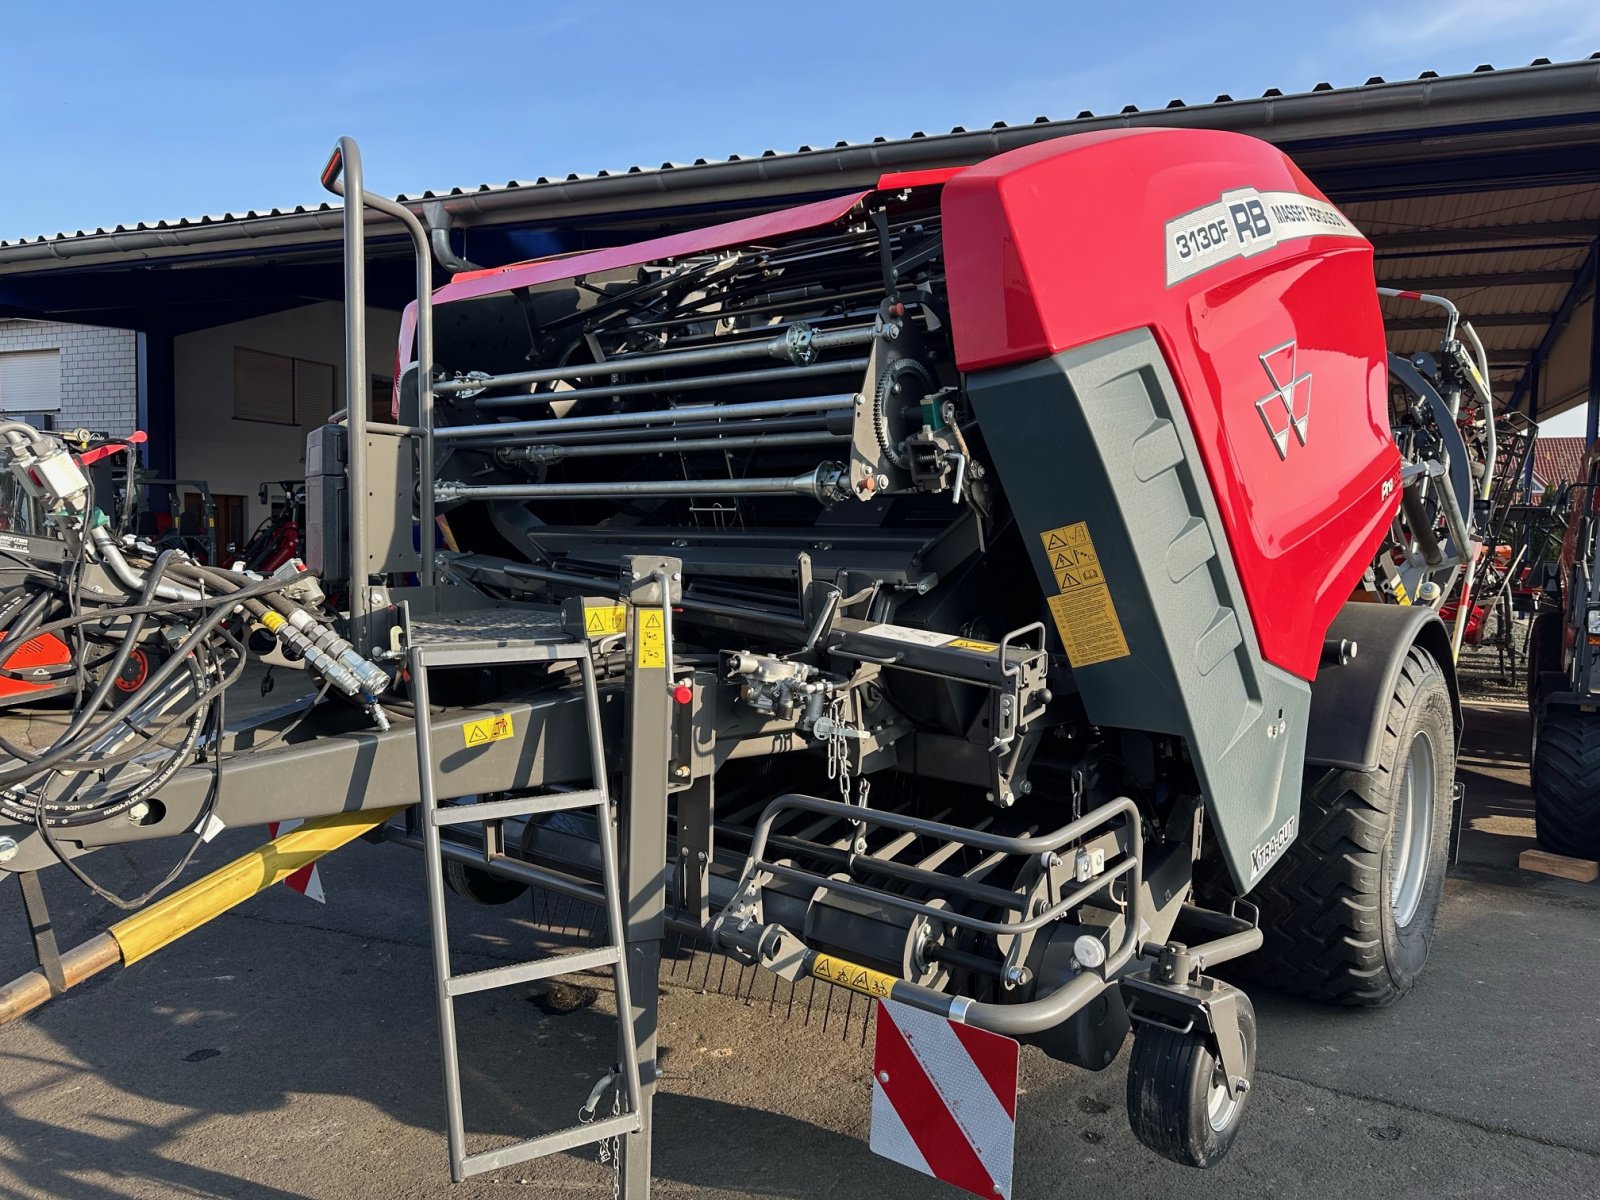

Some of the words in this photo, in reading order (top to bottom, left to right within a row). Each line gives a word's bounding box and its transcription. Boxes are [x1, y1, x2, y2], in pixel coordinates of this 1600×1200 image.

[1175, 218, 1228, 259] 3130F
[1229, 199, 1271, 243] RB
[1270, 204, 1309, 224] MASSEY
[103, 795, 140, 816] HANSA-FLEX
